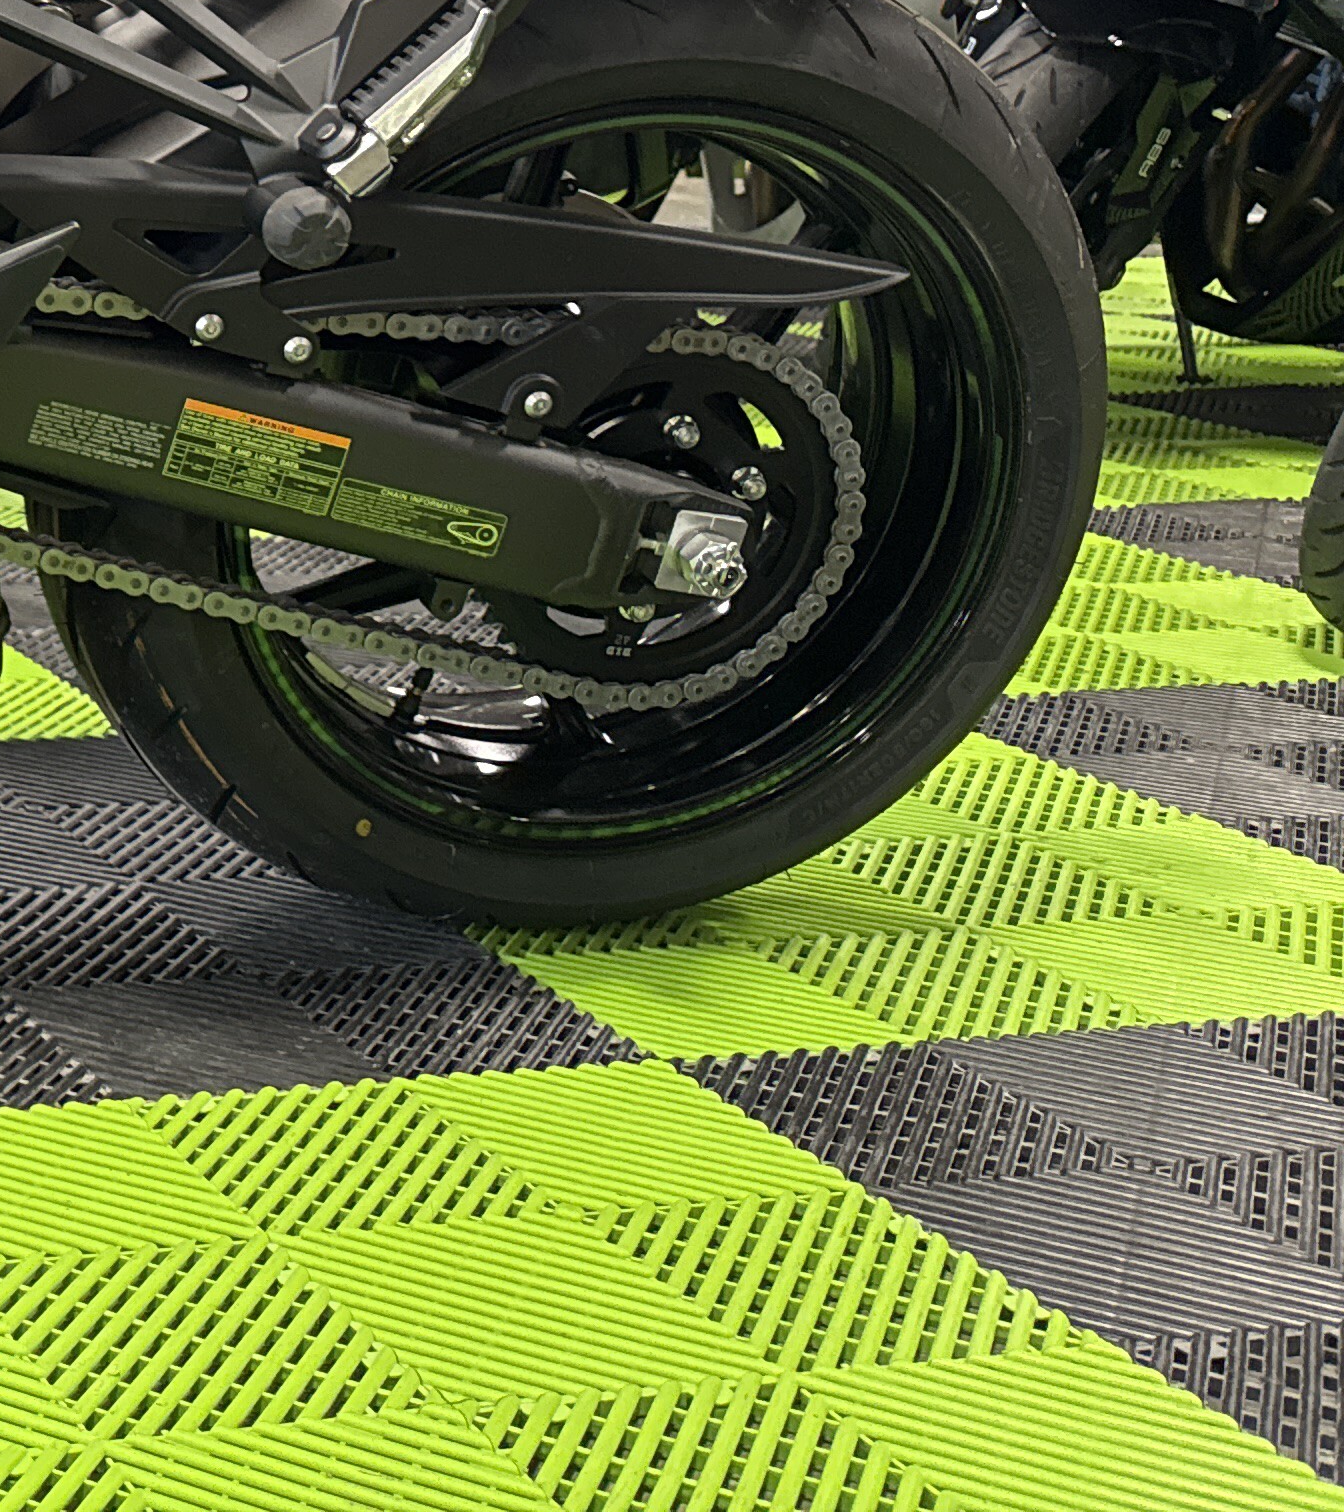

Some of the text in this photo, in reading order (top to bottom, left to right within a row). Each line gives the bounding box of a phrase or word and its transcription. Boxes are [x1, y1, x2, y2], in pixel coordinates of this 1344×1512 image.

[1138, 128, 1172, 178] ABS
[249, 417, 295, 434] WARNING
[234, 448, 252, 457] AND
[254, 452, 277, 464] LOAD
[279, 459, 300, 470] DATA
[381, 488, 469, 515] CHAIN INFORMATION
